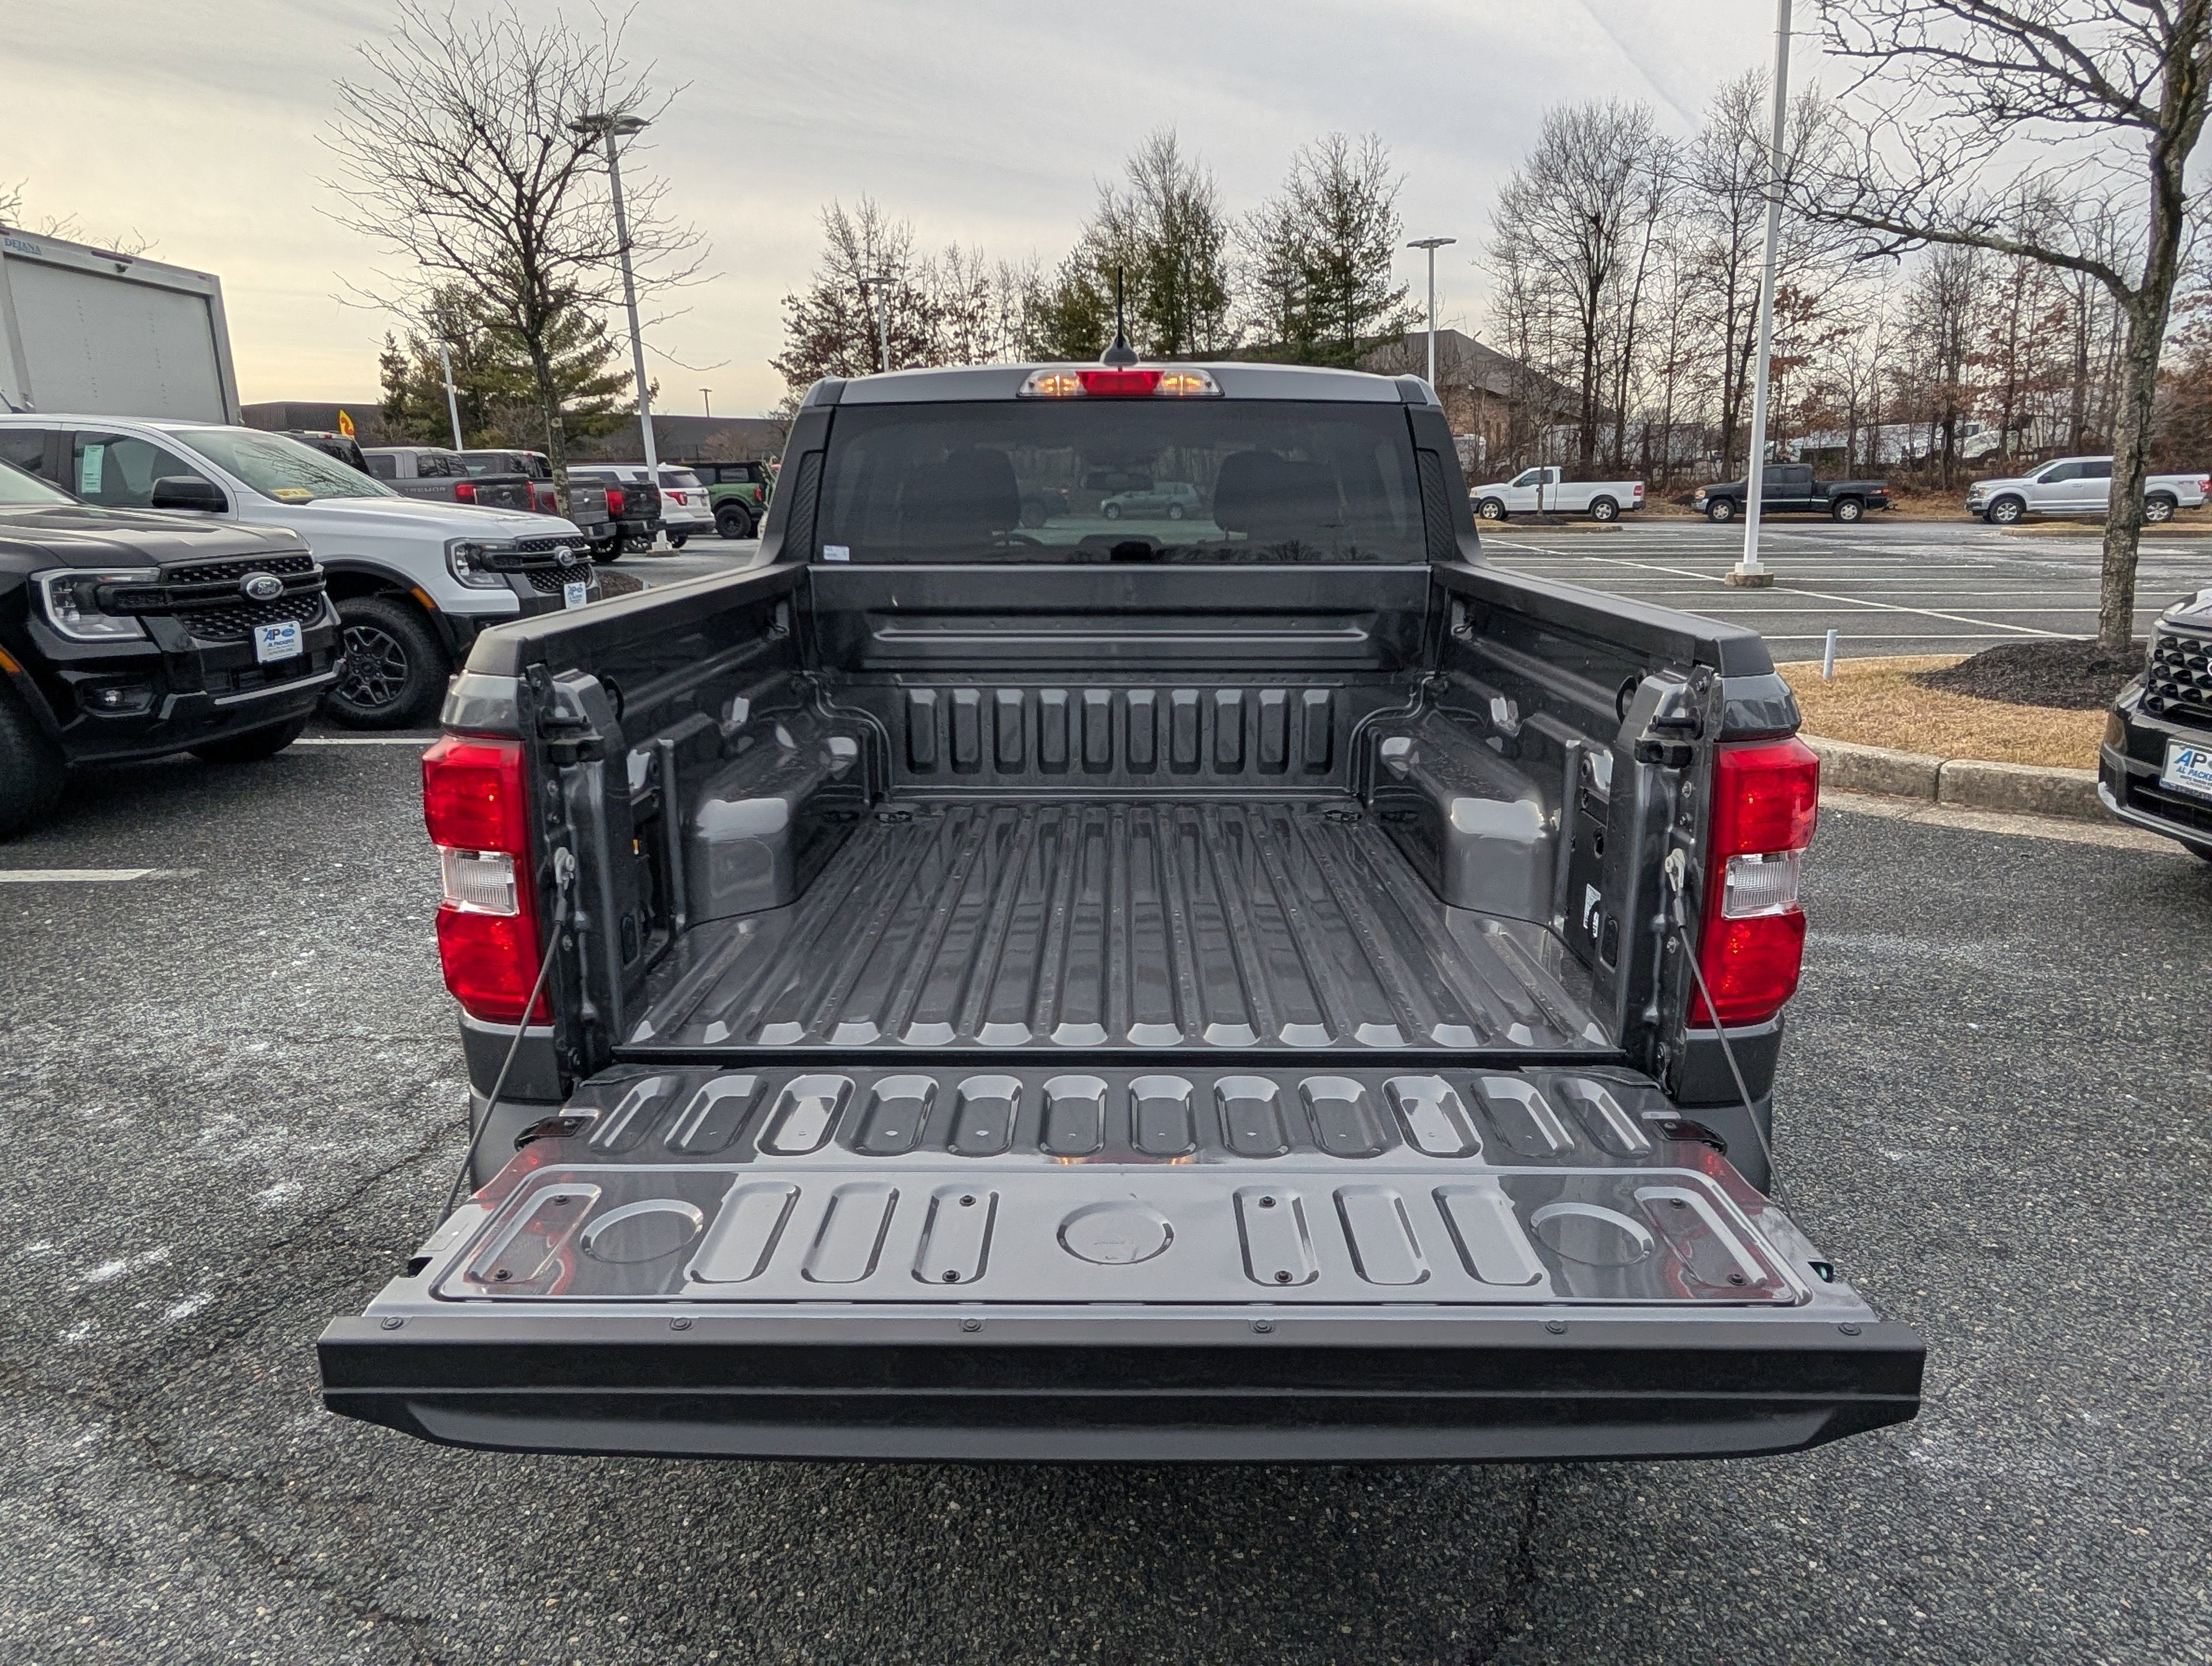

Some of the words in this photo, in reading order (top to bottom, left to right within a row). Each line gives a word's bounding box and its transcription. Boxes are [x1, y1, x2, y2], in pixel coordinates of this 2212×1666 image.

[258, 581, 276, 595] Ford
[263, 629, 281, 642] AP
[2173, 751, 2207, 768] AP
[2176, 766, 2186, 774] AL
